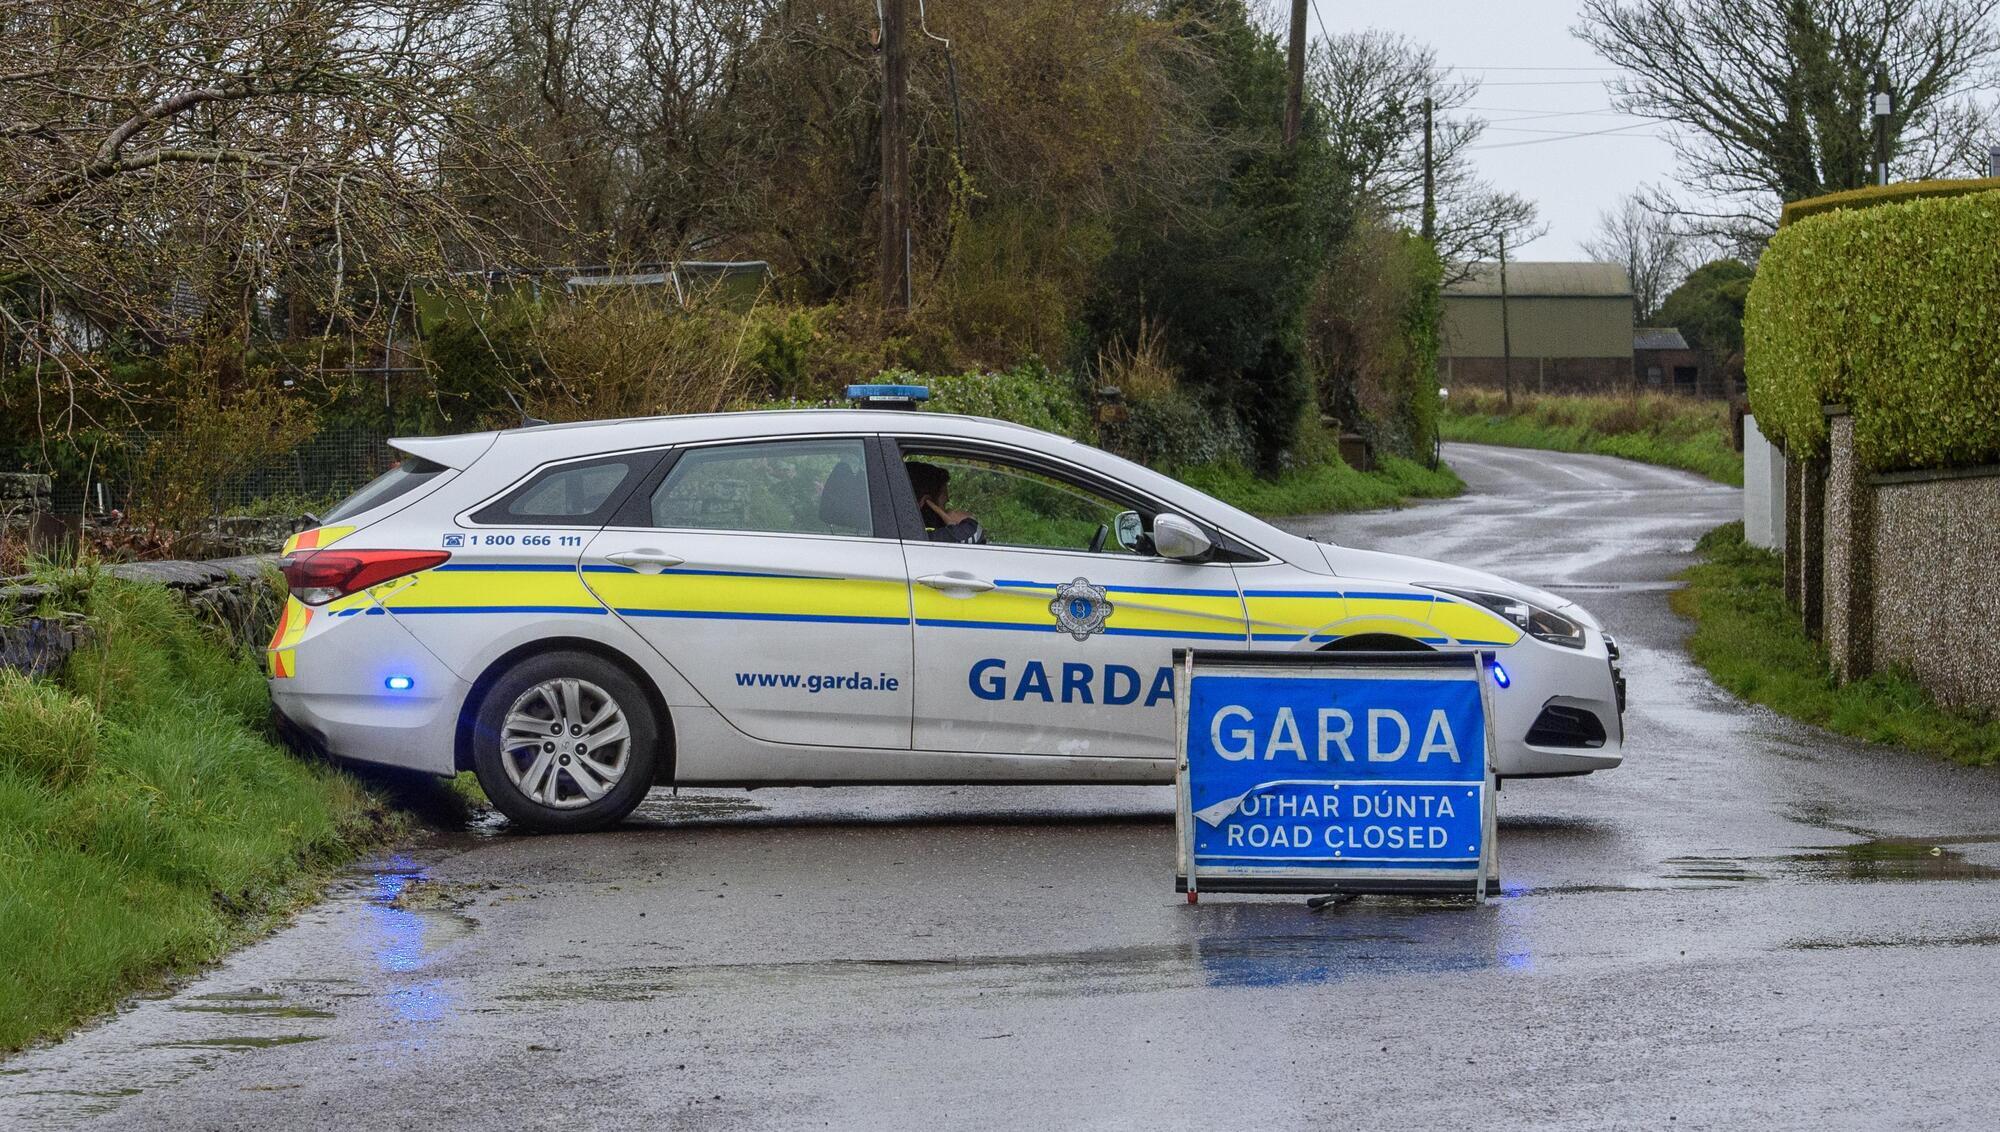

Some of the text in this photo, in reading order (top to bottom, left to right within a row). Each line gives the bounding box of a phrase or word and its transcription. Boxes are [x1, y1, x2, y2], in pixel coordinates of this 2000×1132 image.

[470, 535, 582, 546] 1 800 666 111
[735, 672, 899, 693] www.garda.ie
[968, 658, 1175, 707] GARDA
[1210, 704, 1461, 763] GARDA
[1228, 790, 1455, 818] OTHAR DÚNTA
[1227, 824, 1448, 849] ROAD CLOSED
